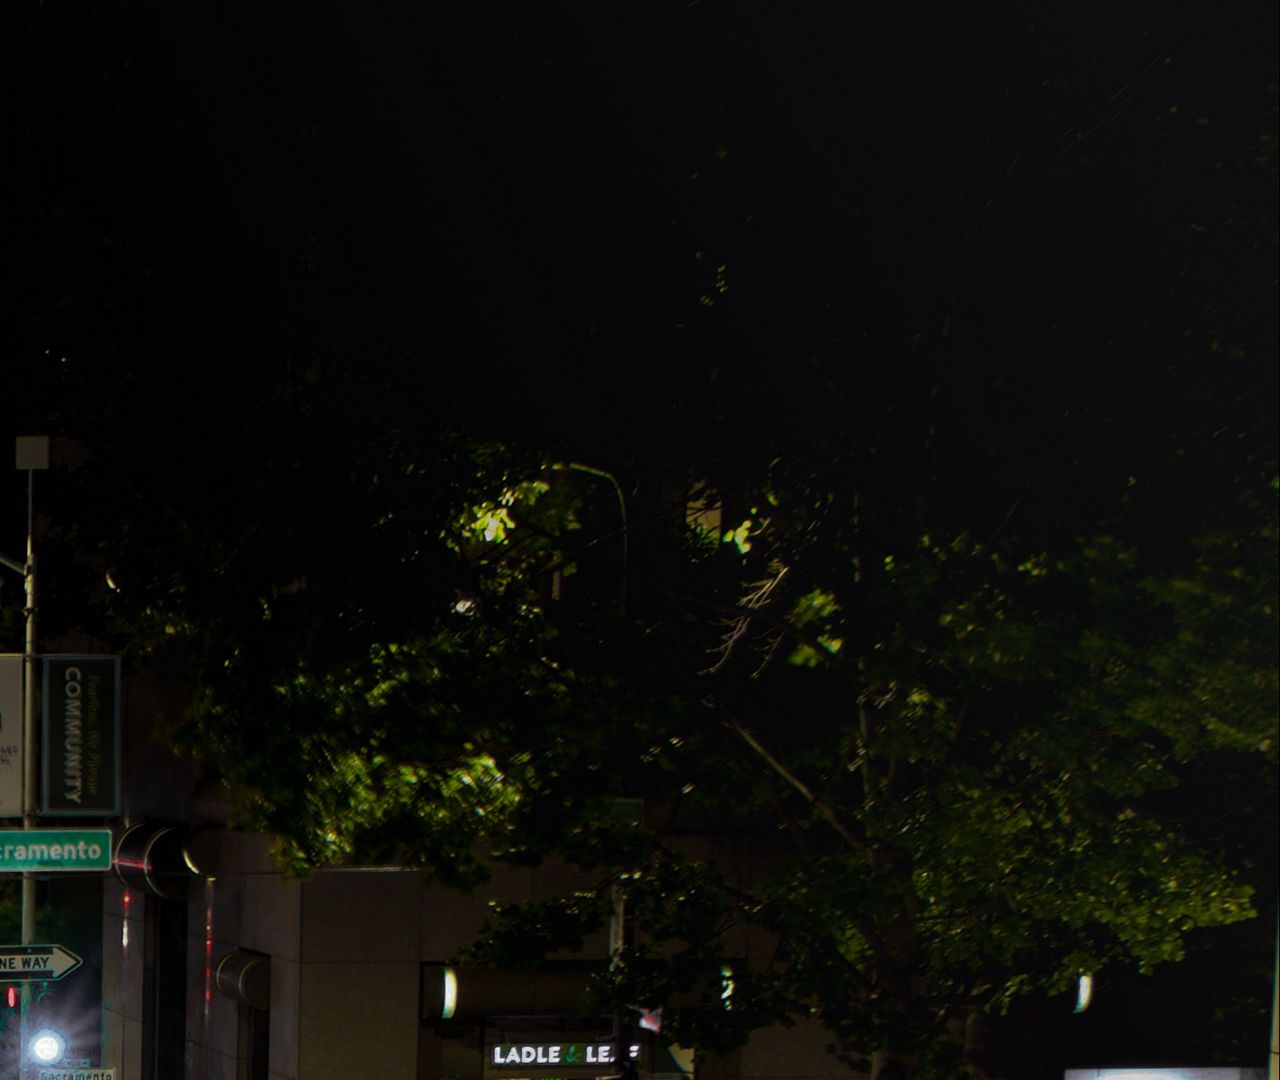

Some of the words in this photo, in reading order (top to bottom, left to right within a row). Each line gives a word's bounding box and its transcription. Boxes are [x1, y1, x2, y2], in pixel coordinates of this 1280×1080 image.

[64, 666, 82, 804] COMMUNITY
[20, 957, 50, 969] WAY
[493, 1045, 561, 1063] LADLE
